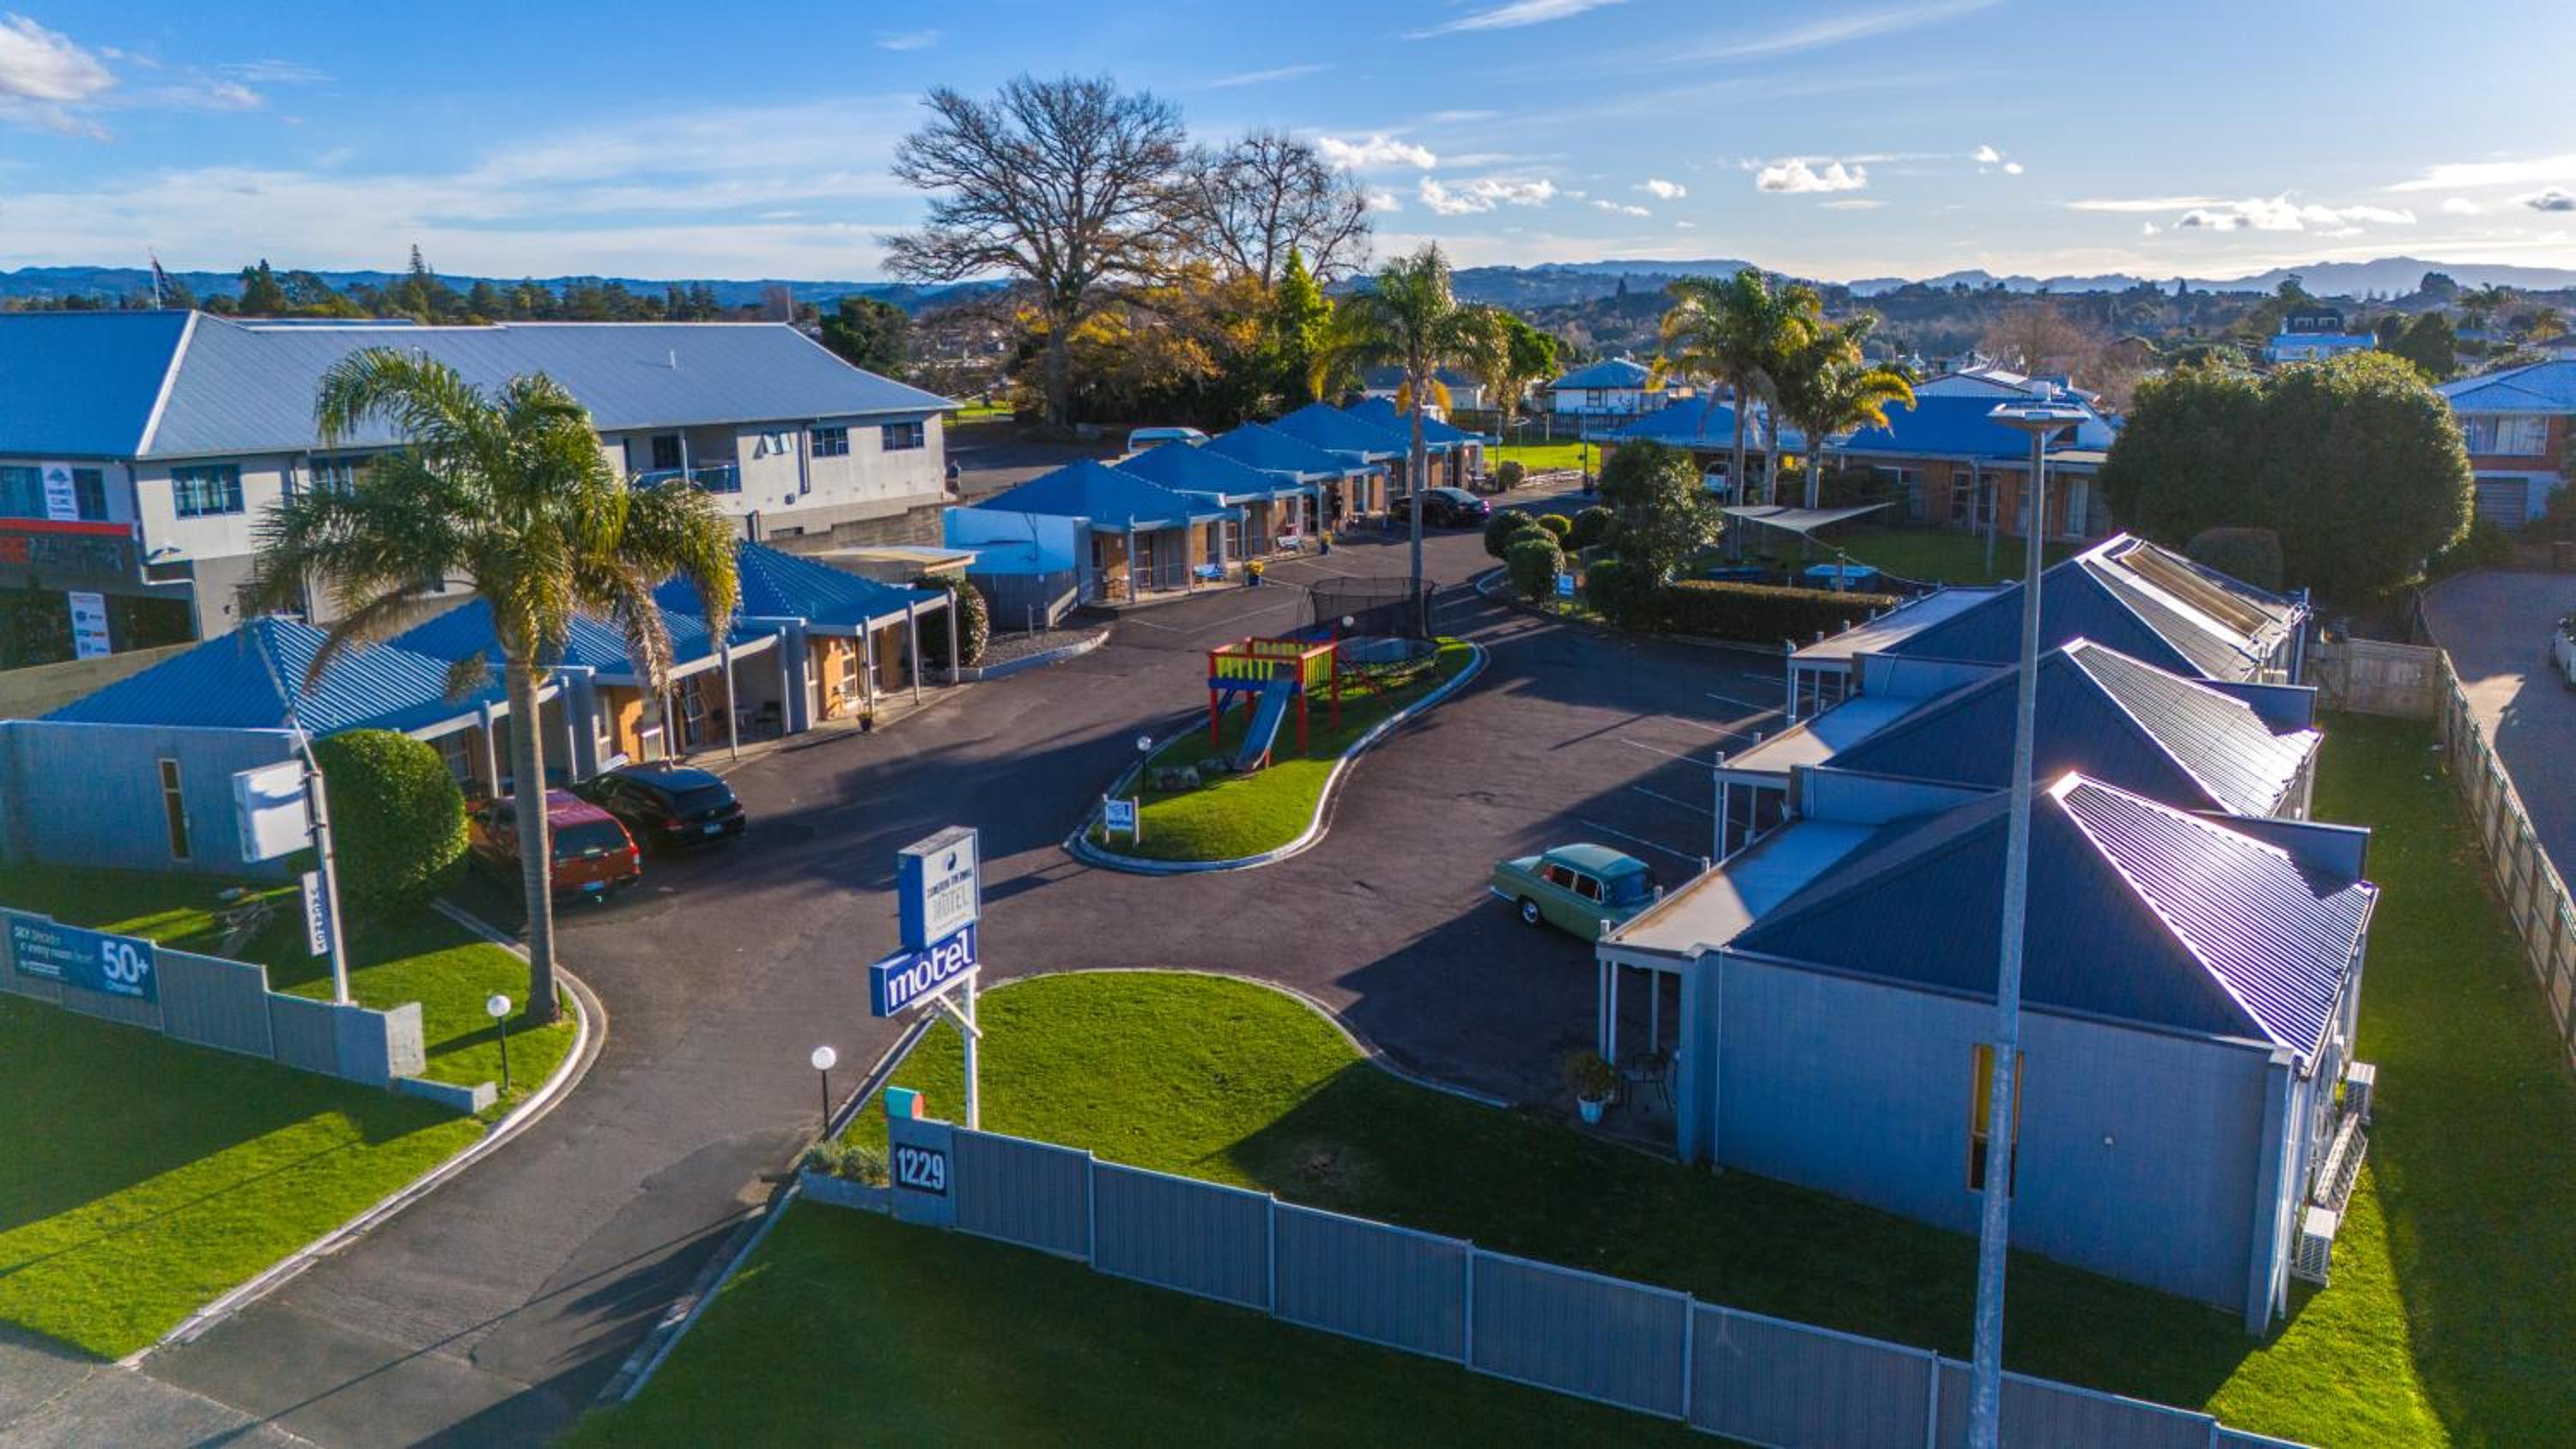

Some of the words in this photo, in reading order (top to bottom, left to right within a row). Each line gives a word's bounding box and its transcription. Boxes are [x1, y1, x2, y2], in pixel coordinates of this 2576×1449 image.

[101, 939, 149, 984] 50+
[888, 929, 973, 1007] motel
[897, 1148, 945, 1190] 1229
